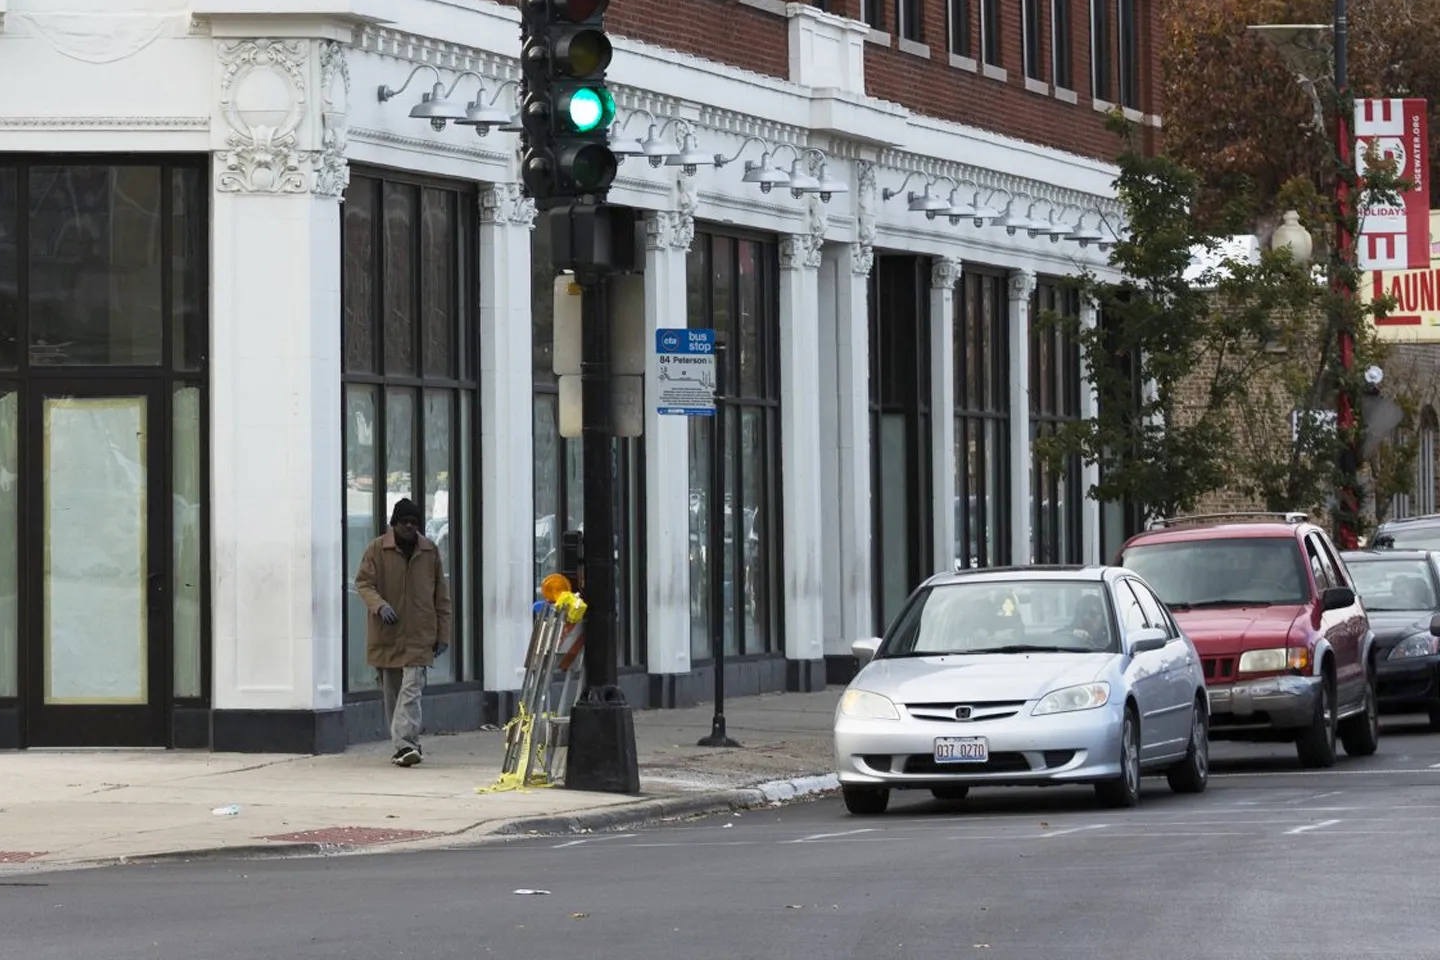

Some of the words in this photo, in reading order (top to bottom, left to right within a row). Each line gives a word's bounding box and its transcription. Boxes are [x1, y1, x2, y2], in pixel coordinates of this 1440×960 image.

[1373, 268, 1440, 326] LAUN
[688, 331, 708, 341] bus
[688, 342, 712, 353] stop
[659, 355, 671, 364] 84
[672, 356, 708, 364] Peterson
[937, 744, 955, 758] 037
[960, 743, 984, 758] 0270
